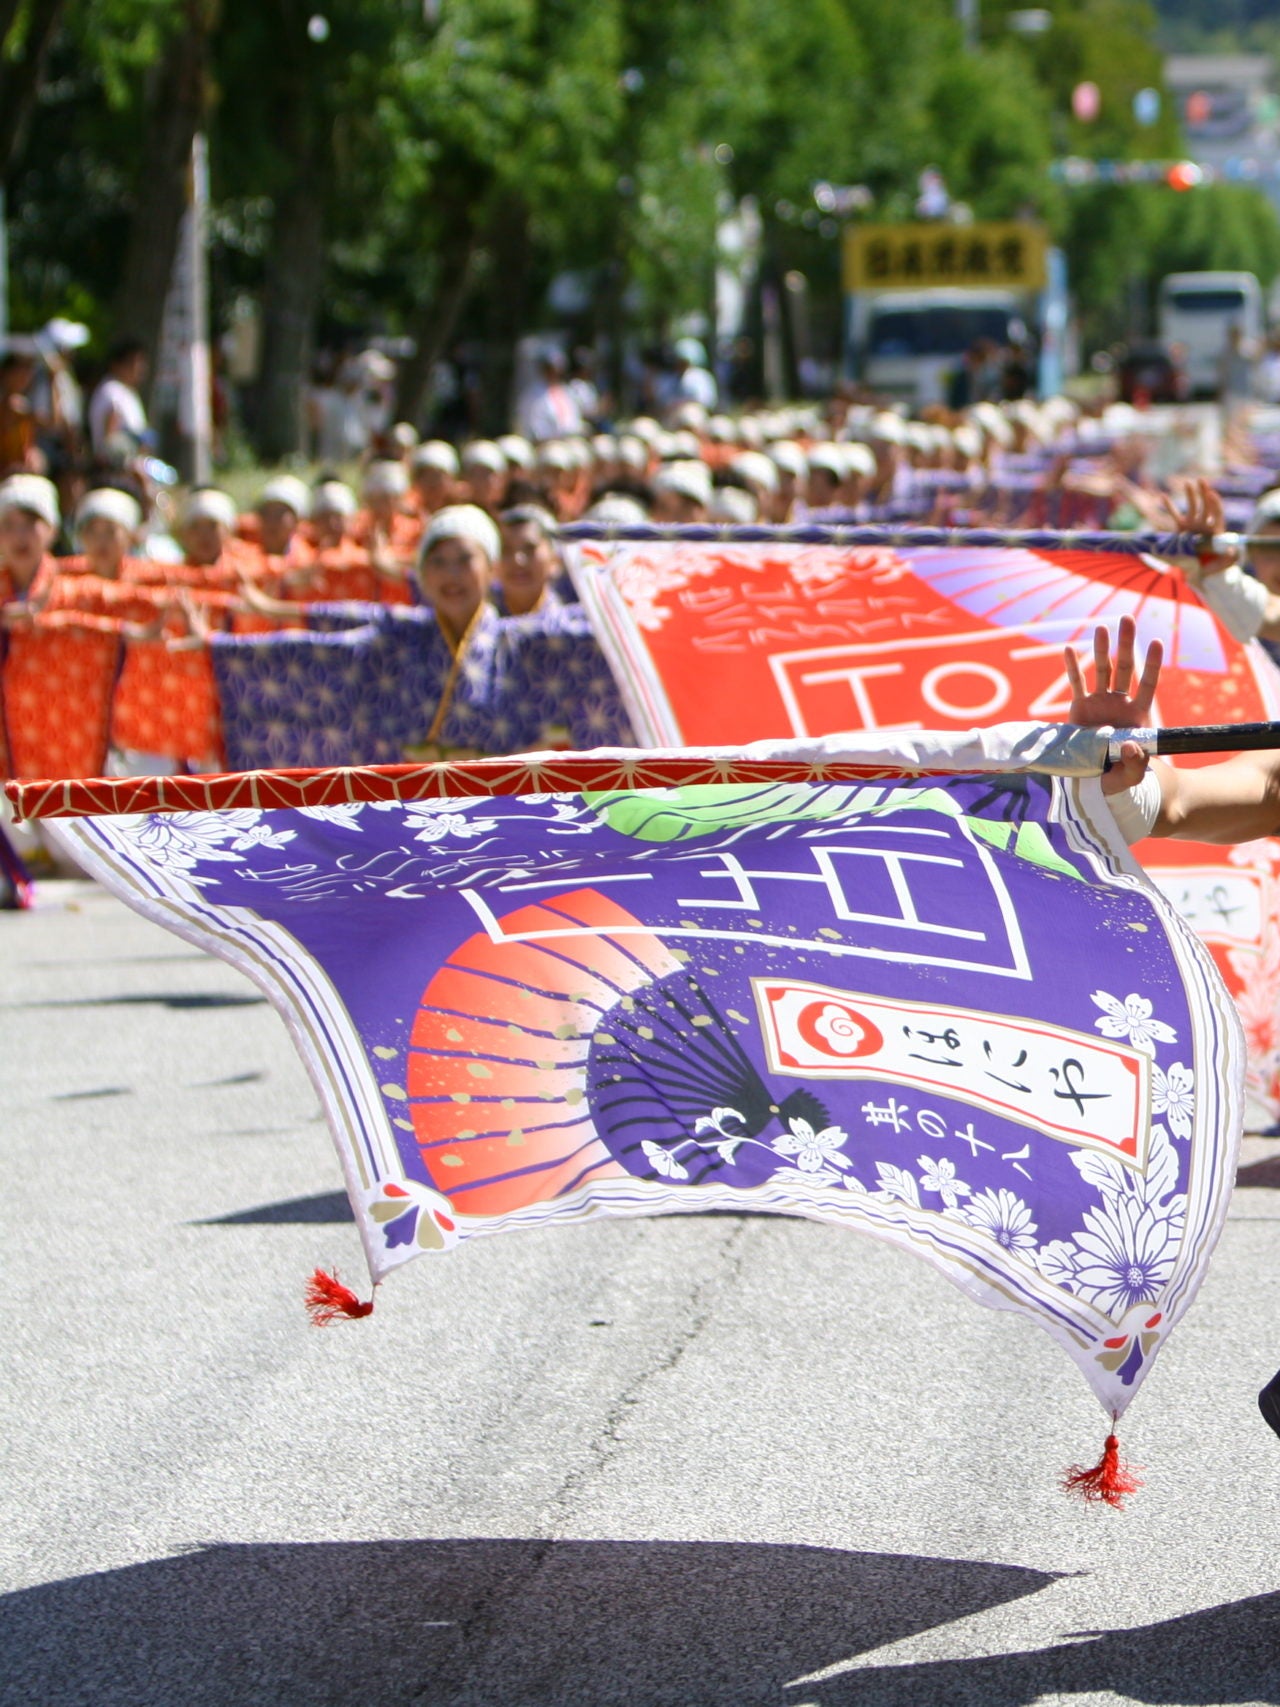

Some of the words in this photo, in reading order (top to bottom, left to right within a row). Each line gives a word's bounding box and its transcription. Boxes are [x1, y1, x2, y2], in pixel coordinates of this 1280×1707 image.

[902, 1024, 1113, 1116] ほにや
[861, 1096, 1034, 1181] 其の十八
